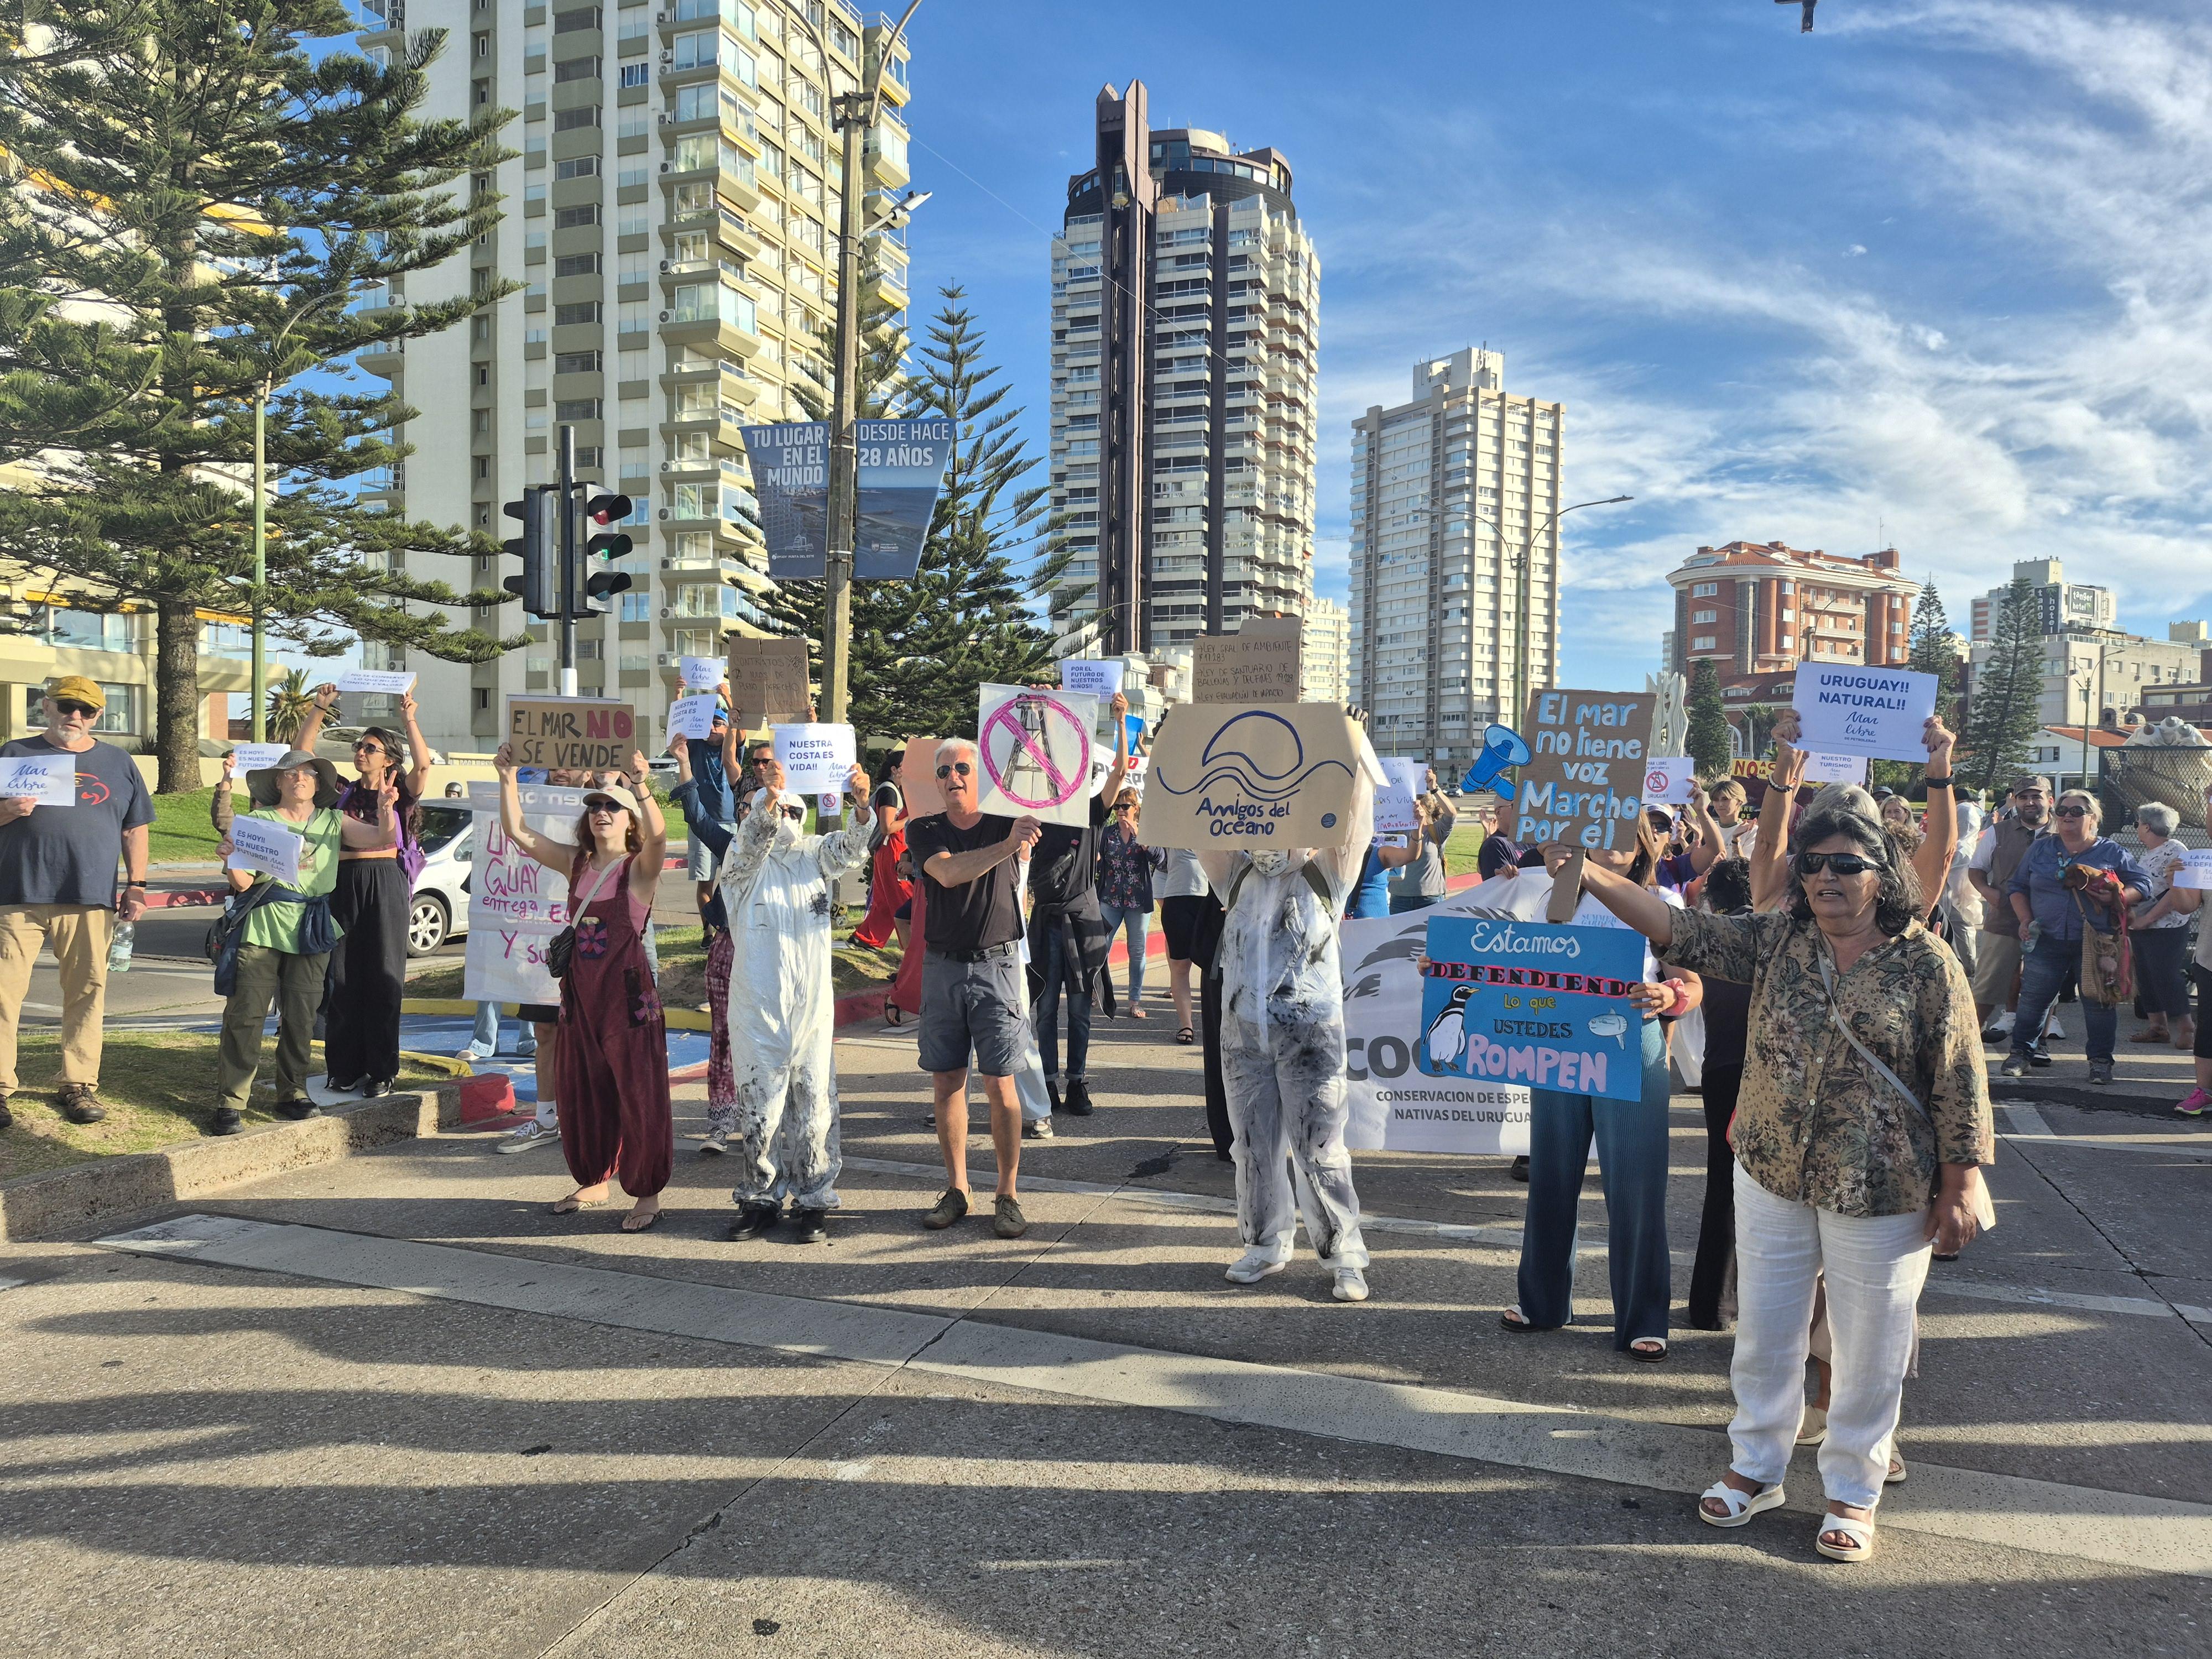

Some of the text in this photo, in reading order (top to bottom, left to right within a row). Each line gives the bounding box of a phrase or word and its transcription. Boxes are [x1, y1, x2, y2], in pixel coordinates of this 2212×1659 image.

[752, 426, 824, 447] TU LUGAR
[860, 423, 950, 441] DESDE HACE
[783, 446, 824, 466] EN EL
[859, 444, 933, 466] 28 AÑOS
[767, 466, 823, 487] MUNDO
[2073, 591, 2093, 601] tanger
[1203, 642, 1215, 653] LEY
[1242, 643, 1251, 652] DE
[1254, 641, 1292, 652] AMBIENTE
[733, 655, 784, 667] CONTRATOS
[1230, 664, 1272, 675] SANTUARIO
[1279, 663, 1288, 672] DE
[1233, 675, 1239, 685] Y
[1820, 674, 1909, 693] URUGUAY!!
[675, 701, 698, 711] NUESTRA
[1538, 693, 1637, 726] El mar
[1819, 692, 1906, 710] NATURAL!!
[673, 709, 687, 718] COSTA
[1845, 711, 1879, 724] Mar
[513, 710, 632, 739] EL MAR NO
[1844, 724, 1876, 736] libre
[1536, 726, 1641, 759] no tiene
[520, 739, 623, 768] SE VENDE
[11, 765, 48, 776] Mar
[1562, 761, 1610, 785] voz
[1734, 760, 1758, 779] NO
[1195, 794, 1291, 821] Amigos del
[1519, 780, 1641, 820] Marcho
[247, 833, 265, 843] HOY!!
[1580, 818, 1615, 850] él
[237, 847, 268, 861] FUTURO!!
[246, 843, 279, 856] NUESTRO
[485, 857, 542, 896] GUAY
[483, 896, 539, 918] entrega
[1582, 914, 1617, 923] SUMMER
[500, 929, 518, 959] Y
[1470, 921, 1581, 958] Estamos
[1430, 962, 1638, 996] DEFENDIENDO
[1504, 993, 1557, 1015] Lo que
[1493, 1019, 1572, 1039] USTEDES
[1466, 1034, 1607, 1092] ROMPEN
[1376, 1090, 1530, 1104] CONSERVACION DE ESPE
[1395, 1108, 1449, 1121] NATIVAS
[1452, 1110, 1475, 1122] DEL
